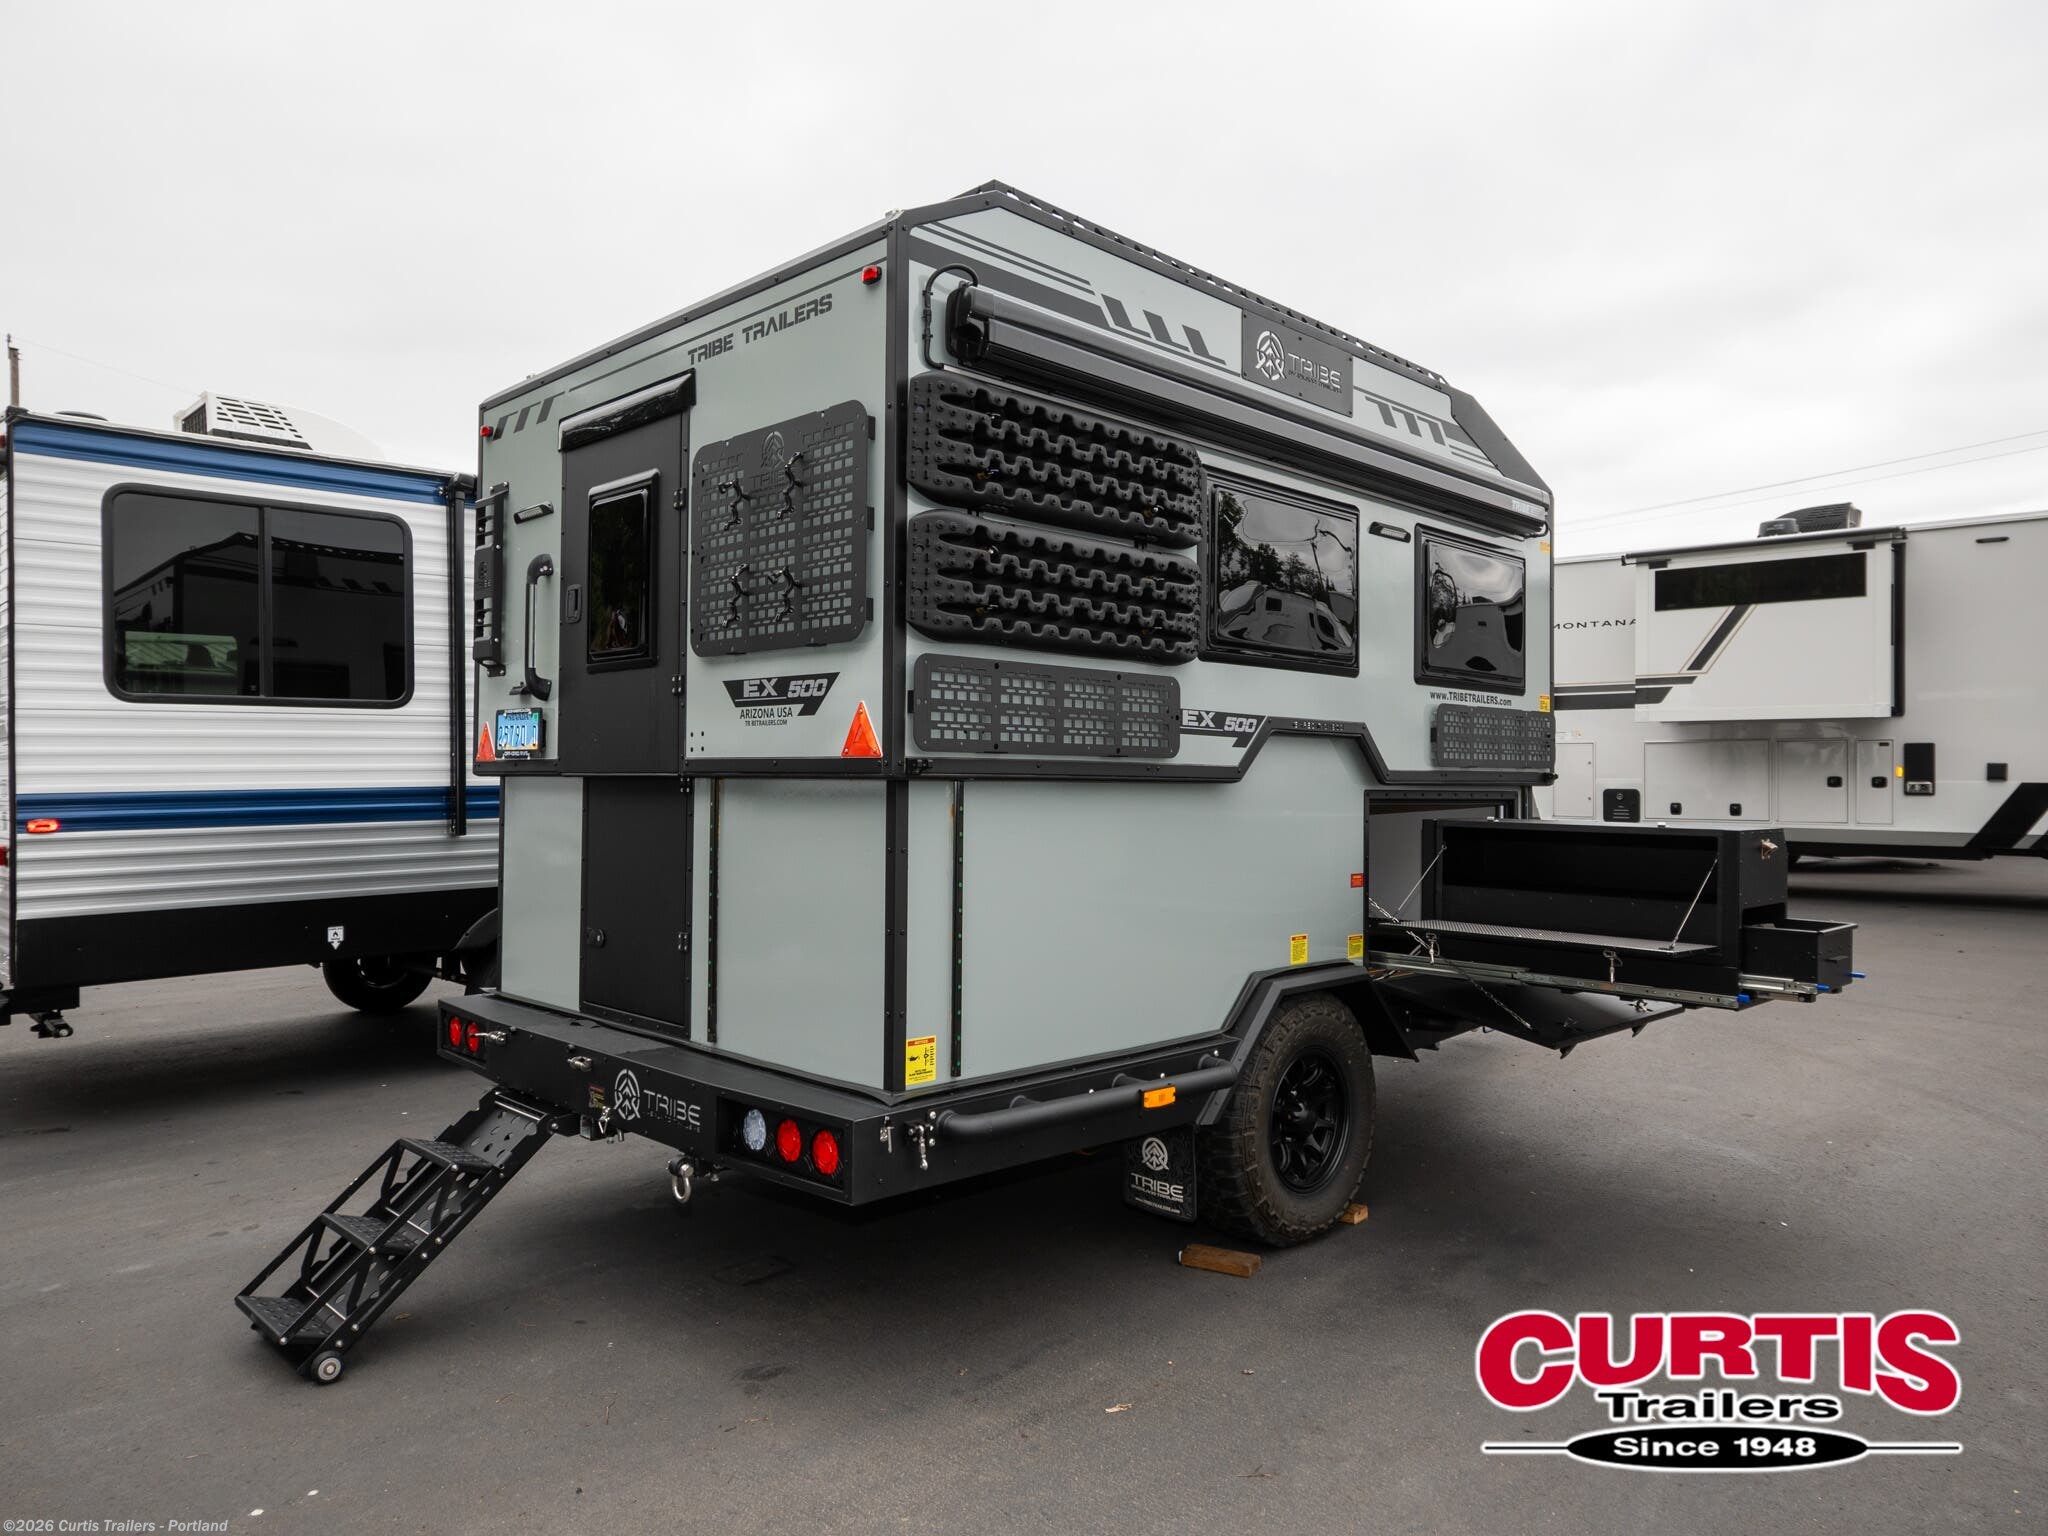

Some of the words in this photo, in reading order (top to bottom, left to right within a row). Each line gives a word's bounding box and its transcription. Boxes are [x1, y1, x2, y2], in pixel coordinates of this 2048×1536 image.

[688, 333, 734, 365] TRIBE
[742, 293, 833, 344] TRAILERS
[1287, 352, 1341, 389] TRIBE
[743, 678, 778, 698] EX
[787, 678, 828, 699] 500
[1429, 690, 1512, 707] www.TRIBETRAILERS.com
[740, 707, 775, 720] ARIZONA
[777, 706, 793, 718] USA
[1182, 709, 1215, 728] EX
[1224, 716, 1257, 733] 500
[643, 1089, 701, 1126] TRIBE
[1131, 1172, 1184, 1198] TRIBE
